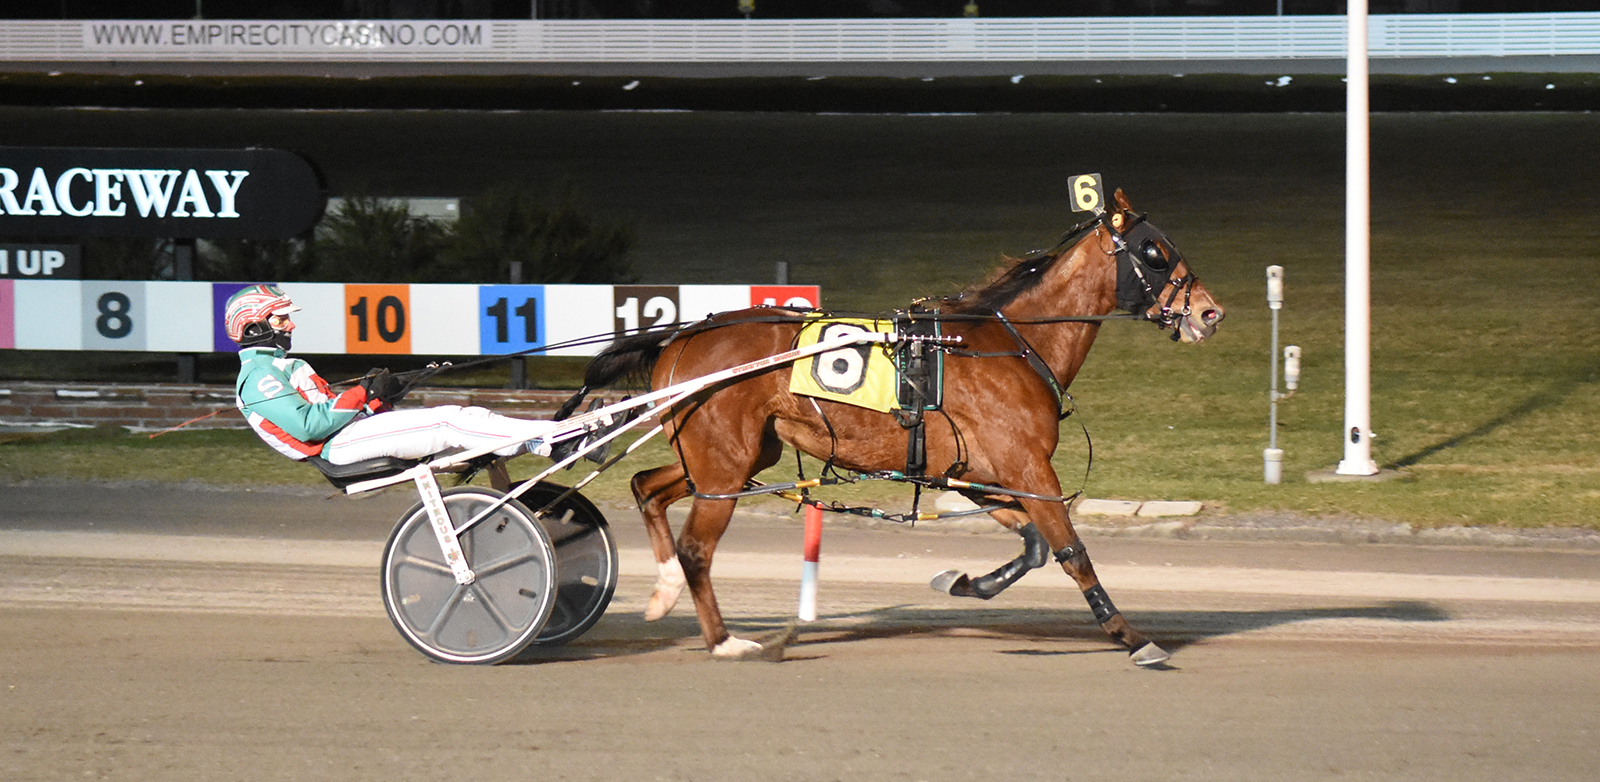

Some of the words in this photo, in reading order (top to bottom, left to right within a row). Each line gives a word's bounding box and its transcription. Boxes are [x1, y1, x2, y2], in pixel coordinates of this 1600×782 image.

[0, 166, 249, 219] RACEWAY
[1074, 174, 1099, 211] 6
[16, 249, 66, 276] UP
[96, 291, 133, 339] 8
[350, 295, 405, 343] 10
[487, 297, 537, 343] 11
[615, 296, 677, 337] 12
[812, 322, 870, 393] 6
[256, 373, 285, 400] S
